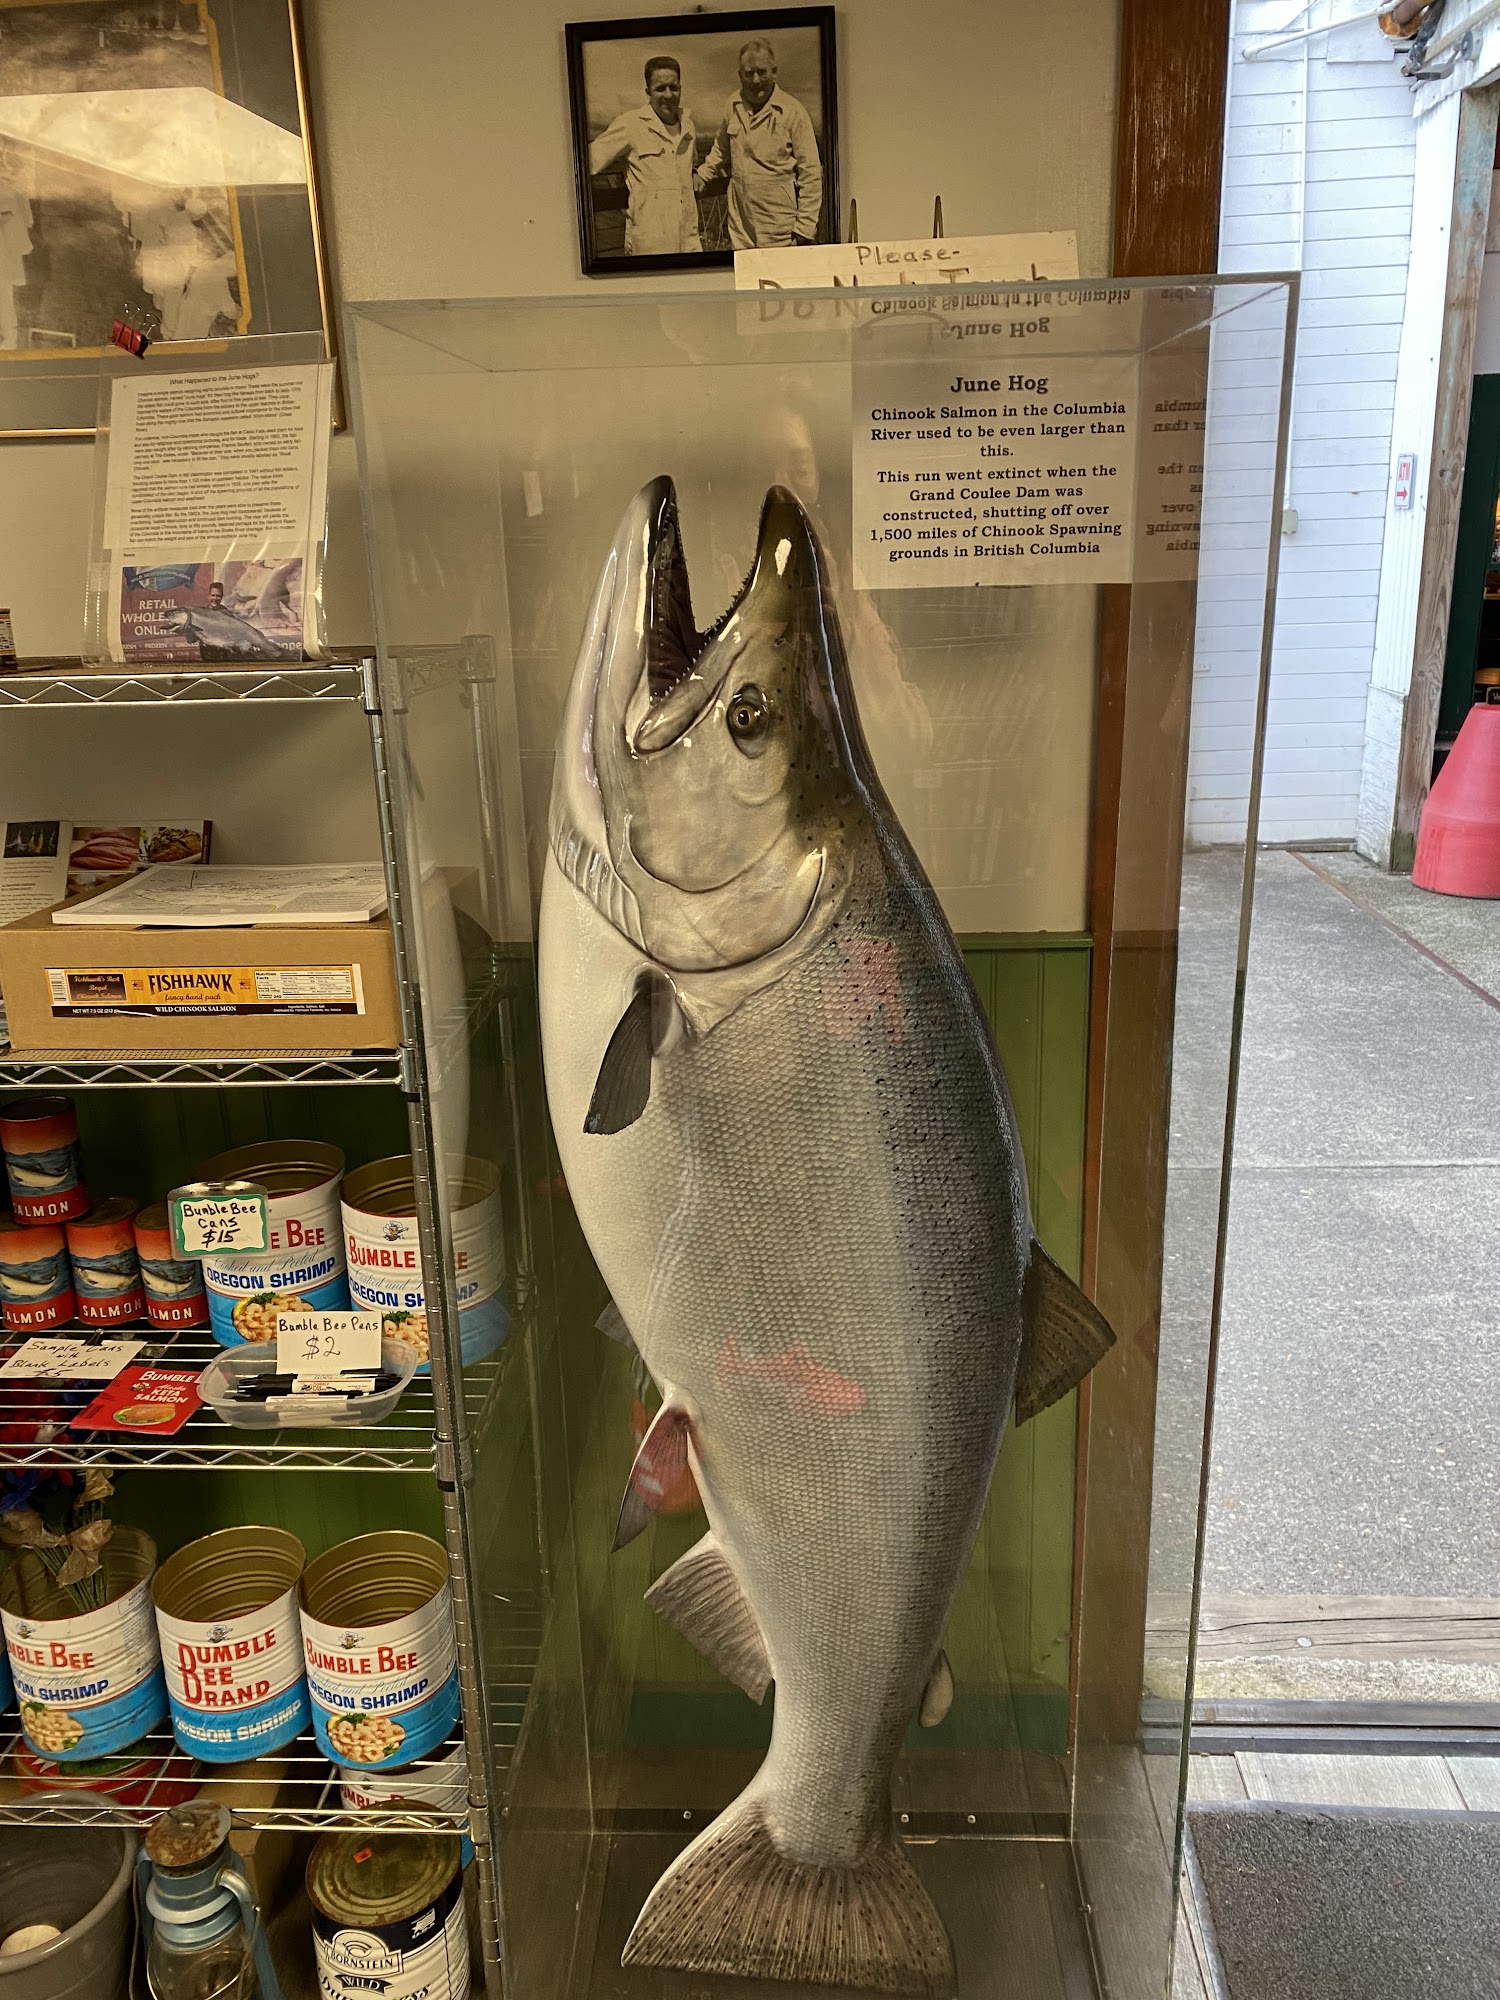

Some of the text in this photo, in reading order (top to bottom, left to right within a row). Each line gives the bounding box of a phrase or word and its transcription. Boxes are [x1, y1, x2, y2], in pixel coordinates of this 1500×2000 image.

[951, 375, 1049, 394] June Hog
[872, 402, 1126, 420] Chinook Salmon in the Columbia
[871, 422, 1125, 440] River used to be even larger than
[980, 445, 1014, 457] this.
[877, 464, 1116, 482] This run went extinct when the
[1398, 462, 1410, 480] ATM
[910, 486, 1083, 501] Grand Coulee Dam was
[883, 504, 1109, 521] constructed, shutting off over
[871, 523, 1121, 543] 1,500 miles of Chinook Spawning
[890, 542, 1100, 562] grounds in British Columbia
[139, 599, 177, 610] RETAIL
[122, 613, 170, 623] WHOLE
[148, 974, 235, 995] FISHHAWK
[183, 1202, 257, 1217] Bumble Bee
[198, 1217, 238, 1229] Cans
[201, 1229, 240, 1248] $15
[286, 1219, 325, 1247] BEE
[348, 1235, 416, 1268] BUMBLE
[207, 1256, 335, 1289] OREGON SHRIMP
[350, 1277, 399, 1307] OREGON
[83, 1299, 142, 1318] SALMON
[279, 1317, 379, 1332] Bumble Bee Pens
[27, 1341, 78, 1354] Sample
[58, 1358, 110, 1367] Labels
[139, 1371, 195, 1382] BUMBLE
[134, 1394, 188, 1403] SALMON
[50, 1642, 95, 1669] BEE
[306, 1637, 418, 1674] BUMBLE BEE
[39, 1680, 109, 1701] SHRIMP
[308, 1675, 429, 1710] REGON SHRIMP
[237, 1699, 302, 1741] SHRIMP
[330, 1952, 393, 1969] BORNSTEIN
[342, 1976, 381, 1989] WILD
